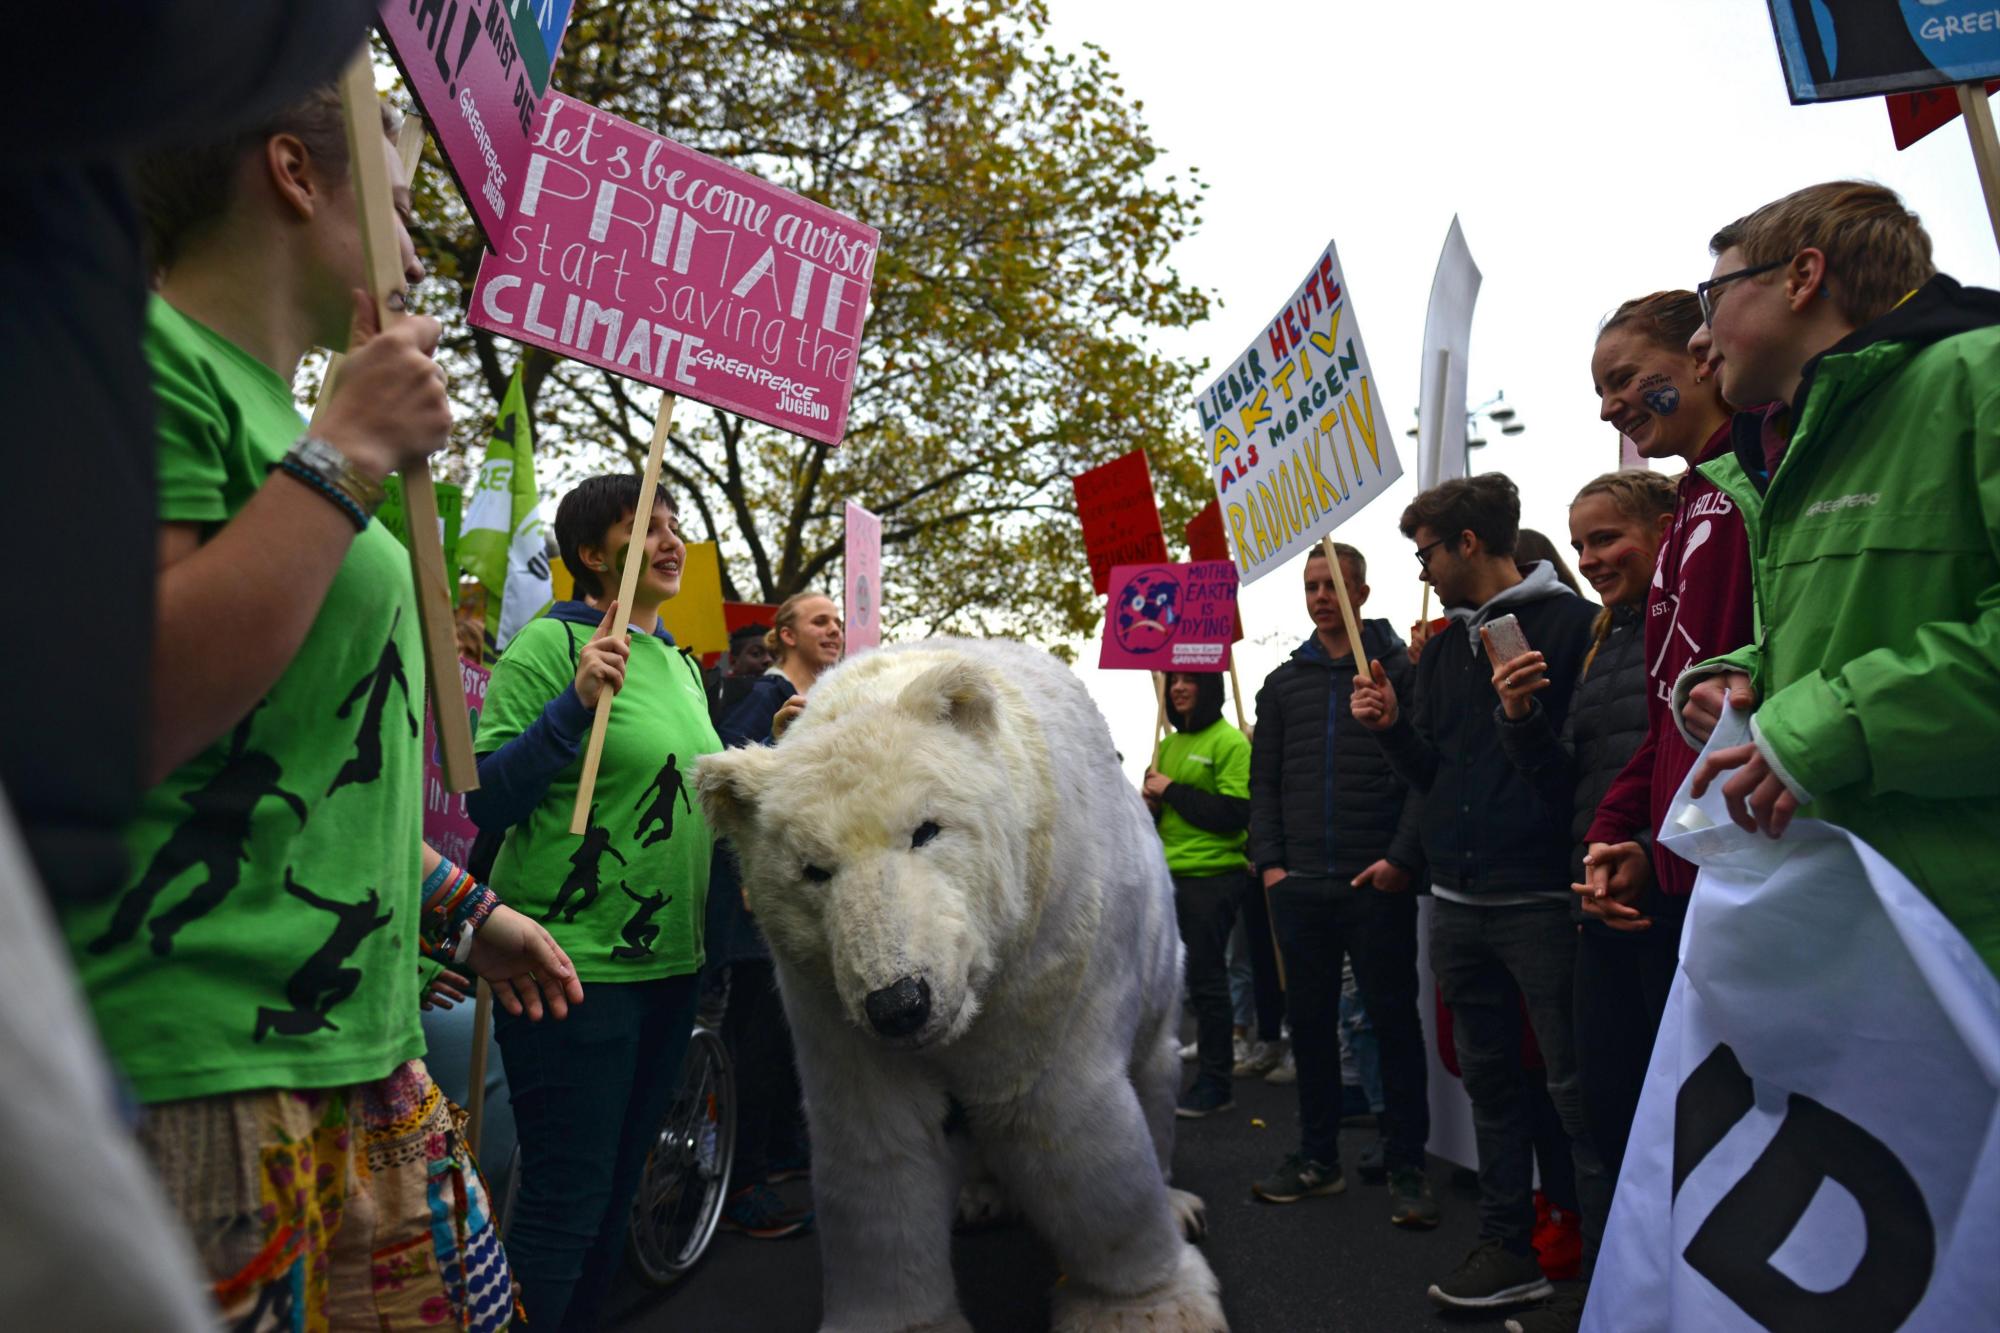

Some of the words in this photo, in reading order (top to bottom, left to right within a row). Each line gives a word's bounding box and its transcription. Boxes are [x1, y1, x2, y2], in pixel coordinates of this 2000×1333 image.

[485, 2, 517, 81] HABT
[513, 72, 535, 138] DIE
[460, 87, 507, 190] GREENPEACE
[530, 98, 632, 178] Let's
[640, 140, 769, 236] become
[482, 171, 506, 221] JUGEND
[518, 155, 867, 339] PRIMATE
[483, 276, 705, 386] CLIMATE
[505, 224, 630, 302] start
[649, 277, 788, 365] saving
[794, 331, 854, 382] the
[1269, 252, 1342, 362] HEUTE
[697, 349, 820, 402] GREENPEACE
[776, 392, 830, 422] JUGEND
[1213, 302, 1343, 466] AKTIV
[1221, 444, 1259, 494] ALS
[1269, 338, 1359, 448] MORGEN
[1227, 376, 1382, 574] RADIOAKTIV
[1181, 615, 1232, 639] DYING
[1186, 583, 1238, 601] EARTH
[1201, 603, 1215, 617] IS
[1652, 602, 1670, 617] EST.
[429, 777, 450, 815] IN
